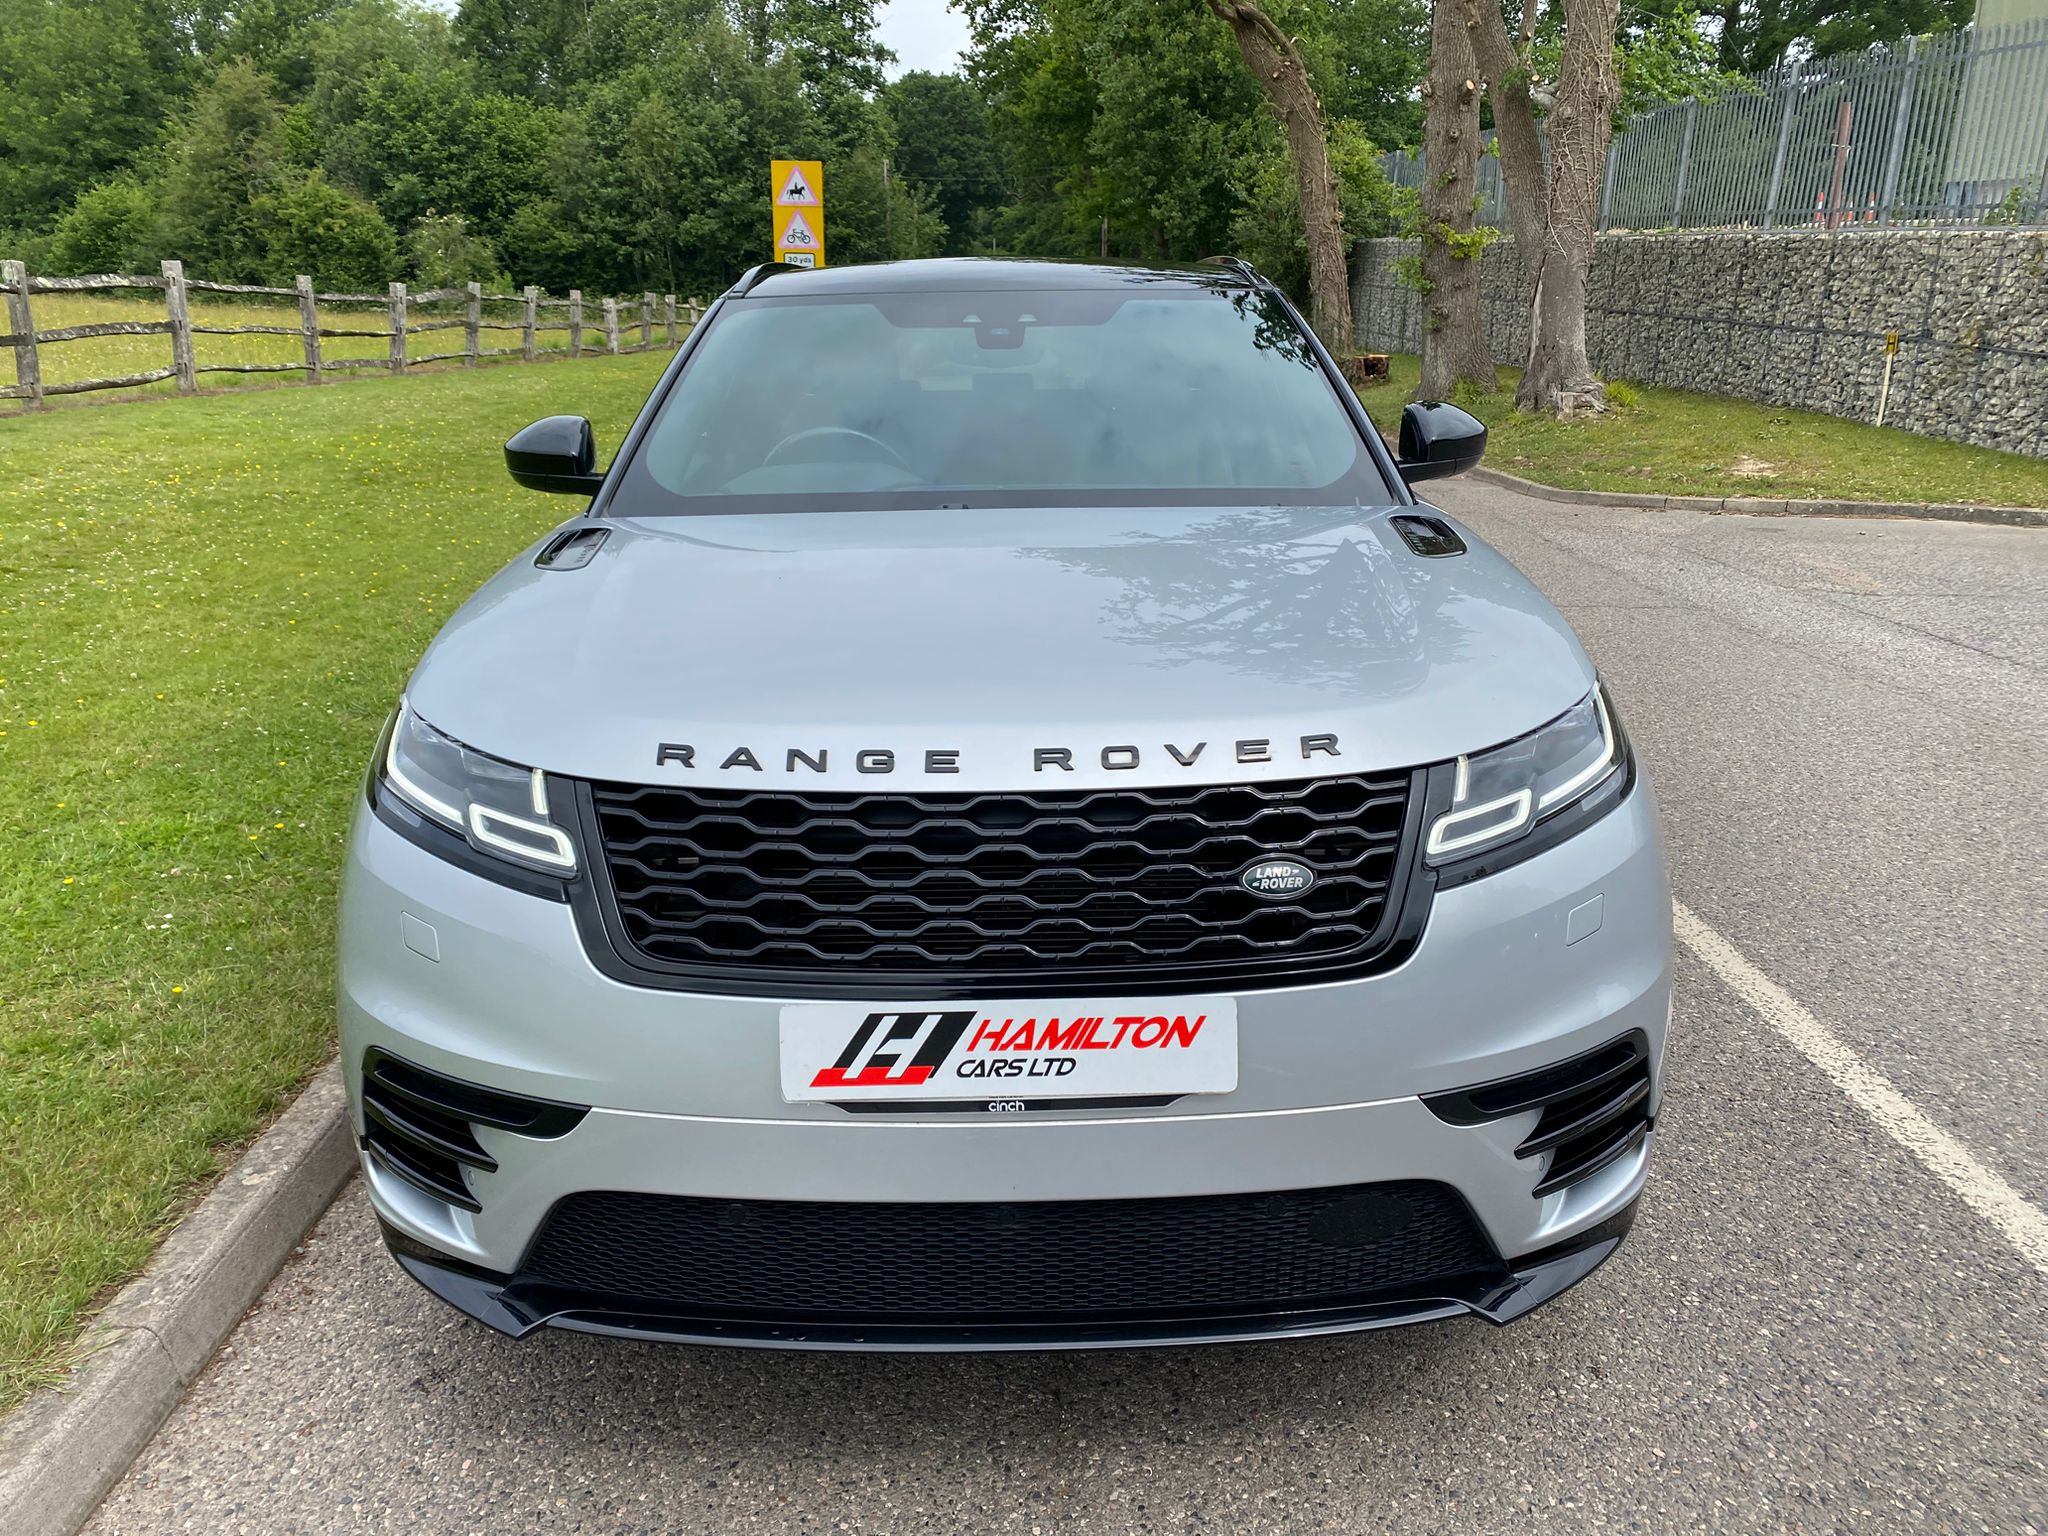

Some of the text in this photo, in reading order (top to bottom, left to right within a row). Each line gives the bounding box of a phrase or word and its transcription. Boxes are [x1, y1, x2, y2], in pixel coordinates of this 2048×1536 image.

[800, 256, 812, 264] yds
[656, 733, 1342, 774] RANGE ROVER
[1256, 867, 1291, 879] LAND
[1260, 877, 1303, 889] ROVER
[966, 1015, 1207, 1052] HAMILTON
[956, 1057, 1077, 1078] CARS LTD
[988, 1100, 1025, 1112] cinch
